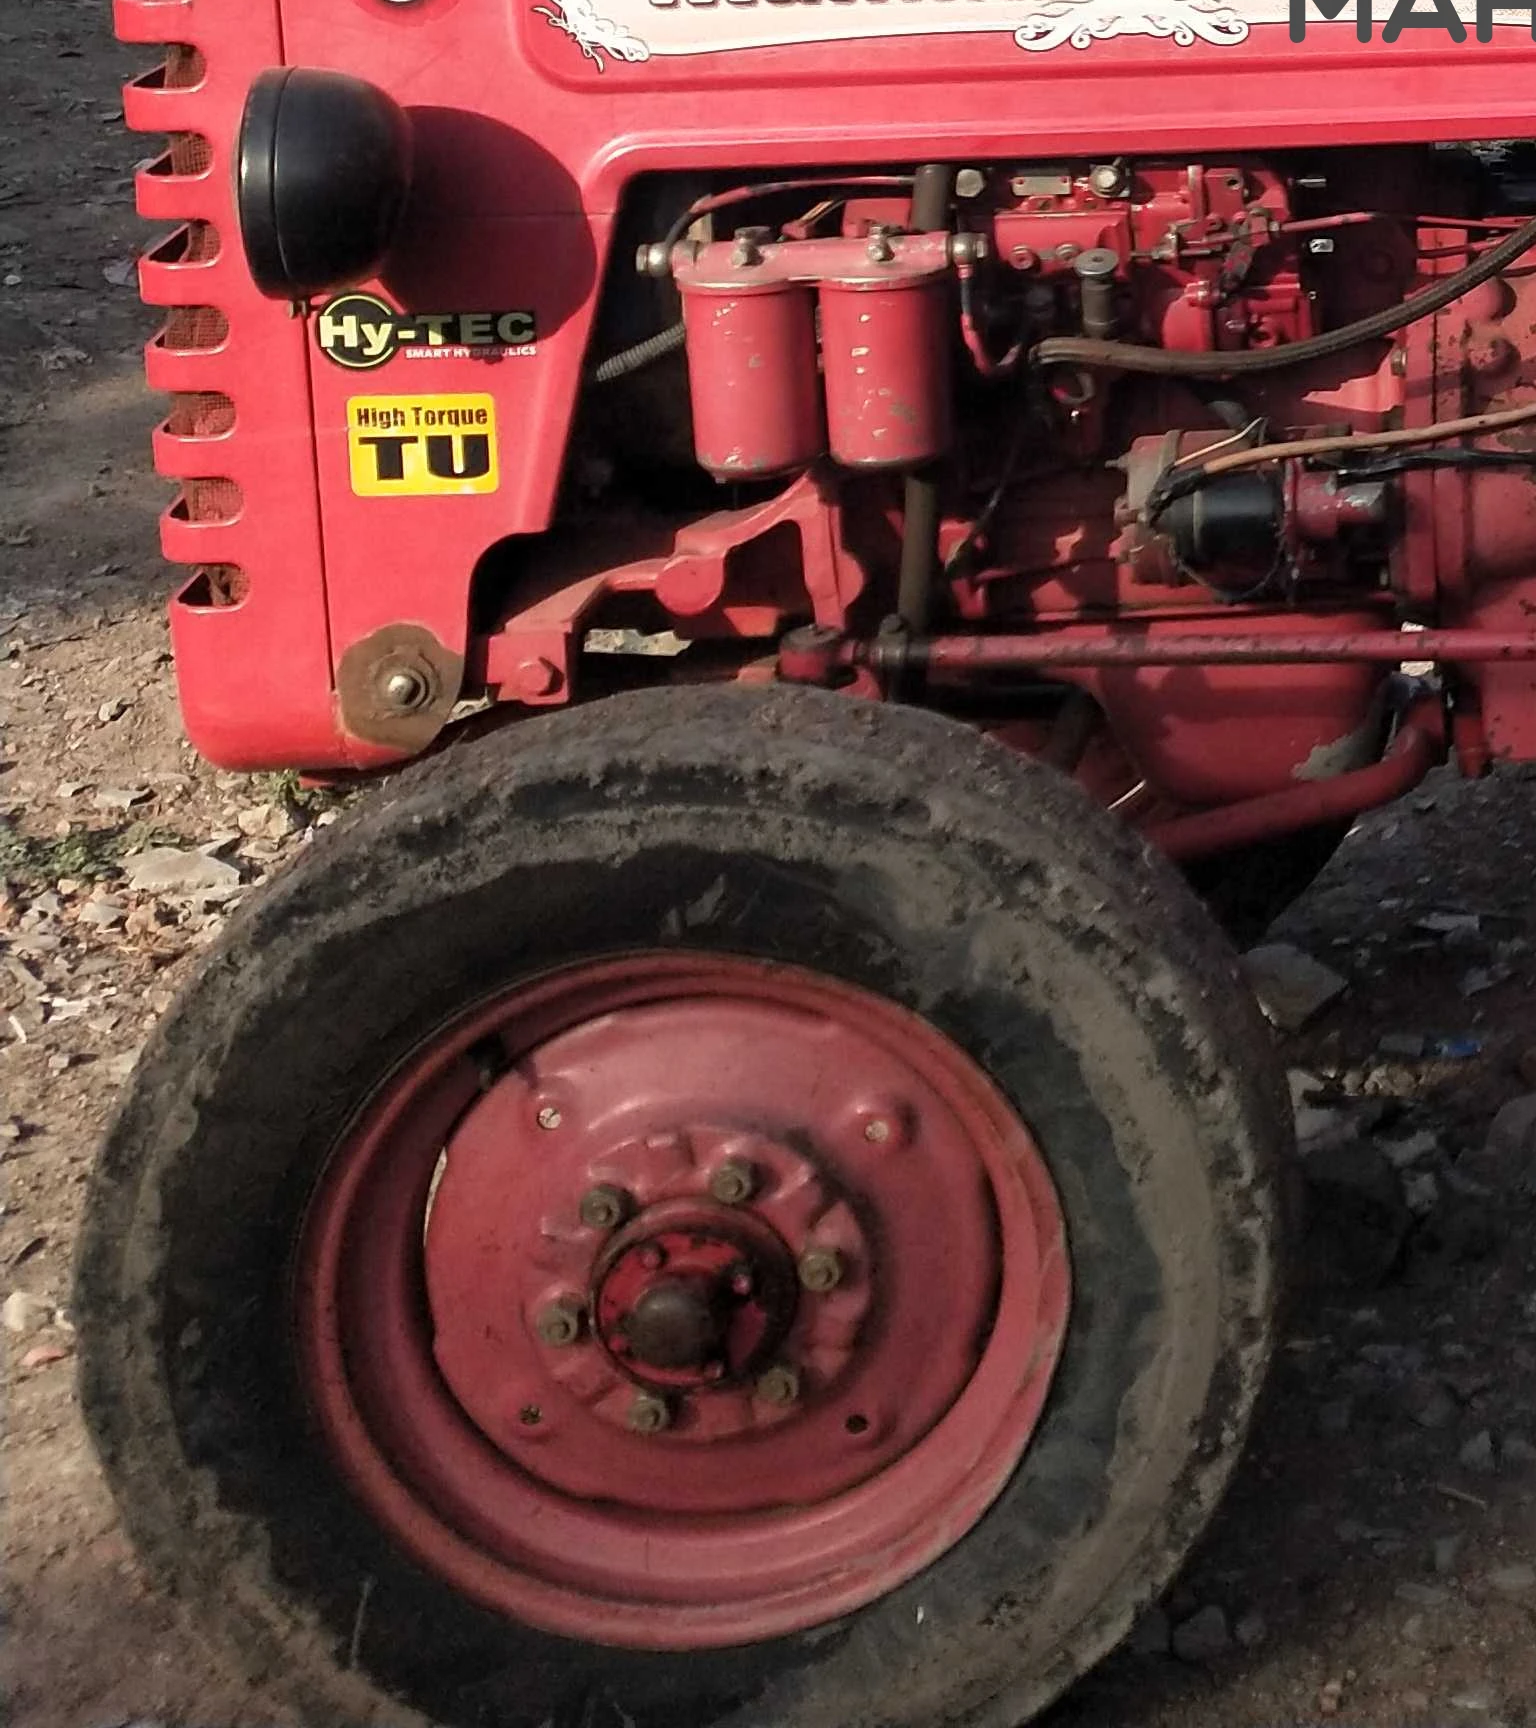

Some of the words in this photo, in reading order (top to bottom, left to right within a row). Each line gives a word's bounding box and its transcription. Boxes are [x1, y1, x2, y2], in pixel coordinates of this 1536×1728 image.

[319, 311, 536, 356] Hy-TEC
[405, 347, 450, 359] SMART
[356, 407, 406, 429] High
[411, 406, 488, 428] Torque
[358, 433, 490, 481] TU
